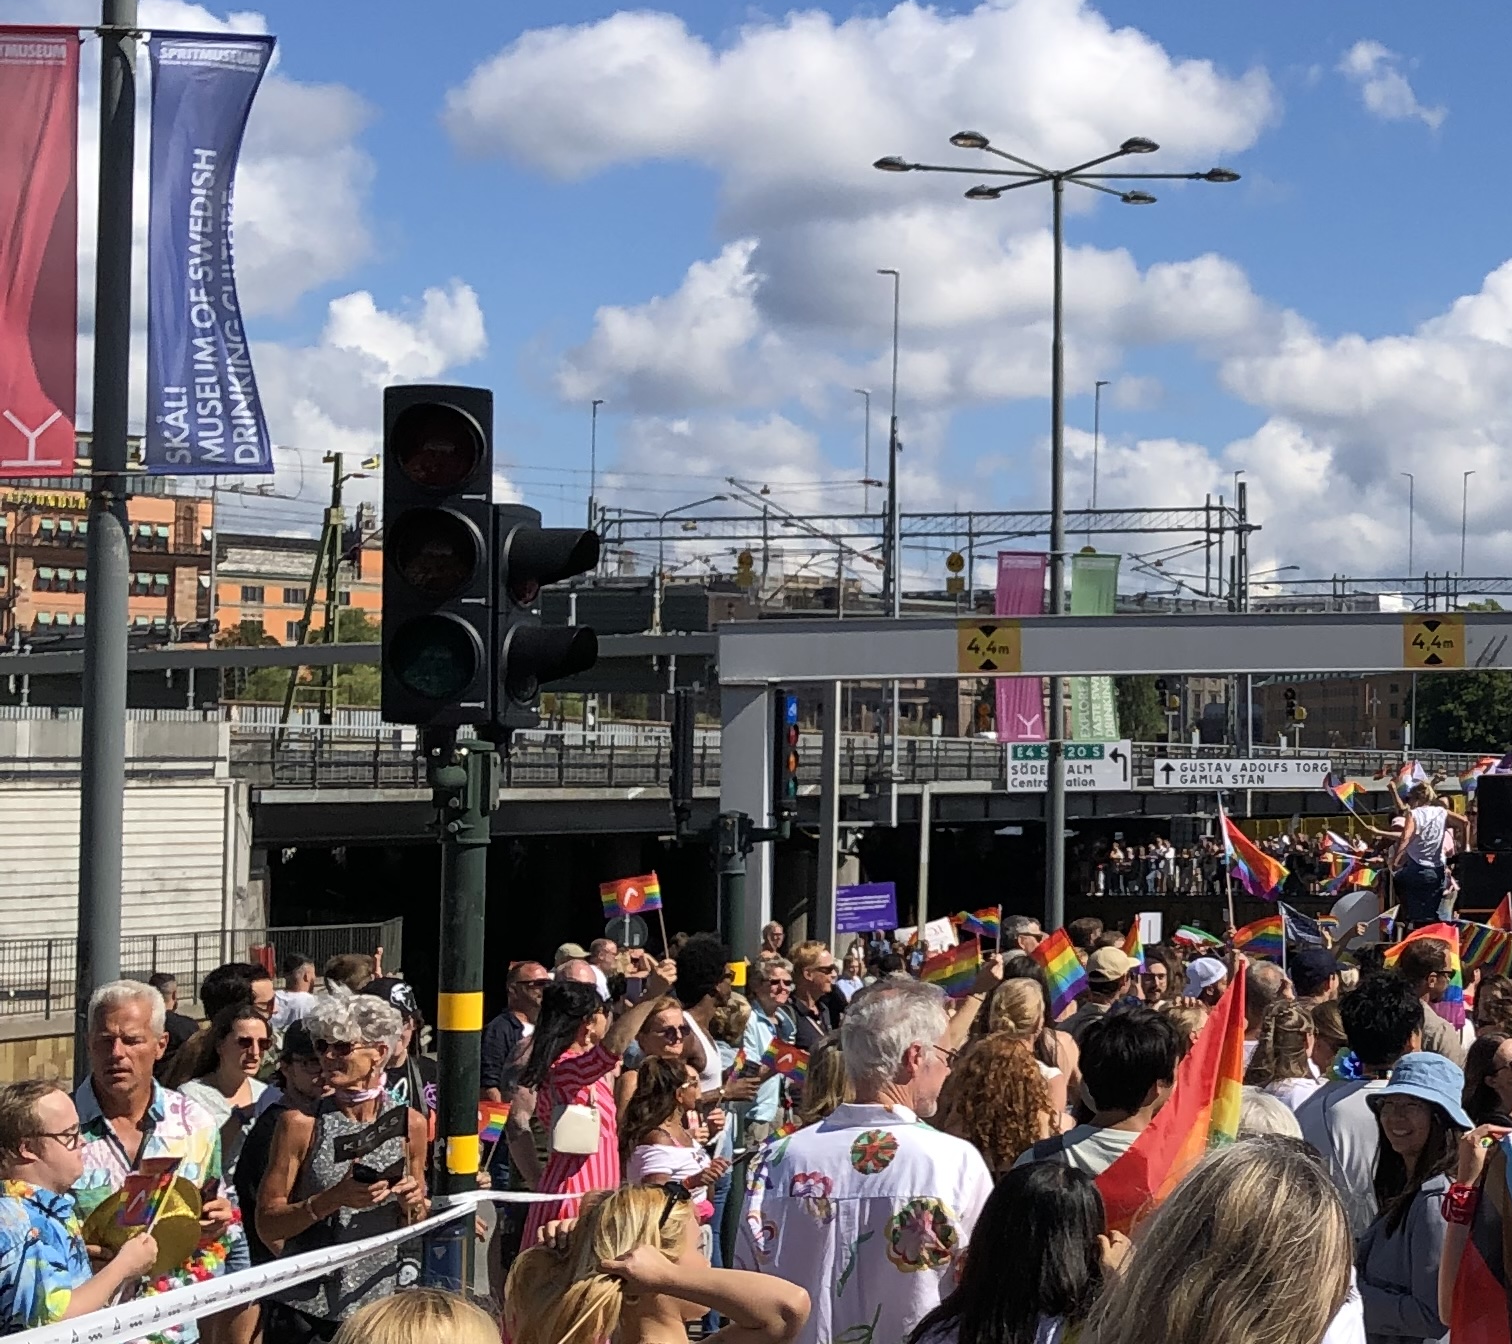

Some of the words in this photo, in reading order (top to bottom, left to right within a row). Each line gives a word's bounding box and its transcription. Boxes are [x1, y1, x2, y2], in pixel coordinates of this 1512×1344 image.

[188, 148, 217, 282] SWEDISH
[190, 287, 217, 329] OF
[192, 336, 227, 463] MUSEUM
[156, 387, 192, 464] SKÅL!
[1091, 676, 1100, 700] SW
[1016, 746, 1035, 758] E4
[1040, 747, 1049, 758] S
[1092, 746, 1101, 757] S
[1011, 762, 1093, 775] SÖDEALM
[1179, 762, 1232, 773] GUSTAV
[1239, 762, 1289, 773] ADOLFS
[1294, 762, 1328, 773] TORG
[1179, 774, 1224, 785] GAMLA
[1231, 774, 1265, 785] STAN
[343, 1116, 400, 1151] KICKS
